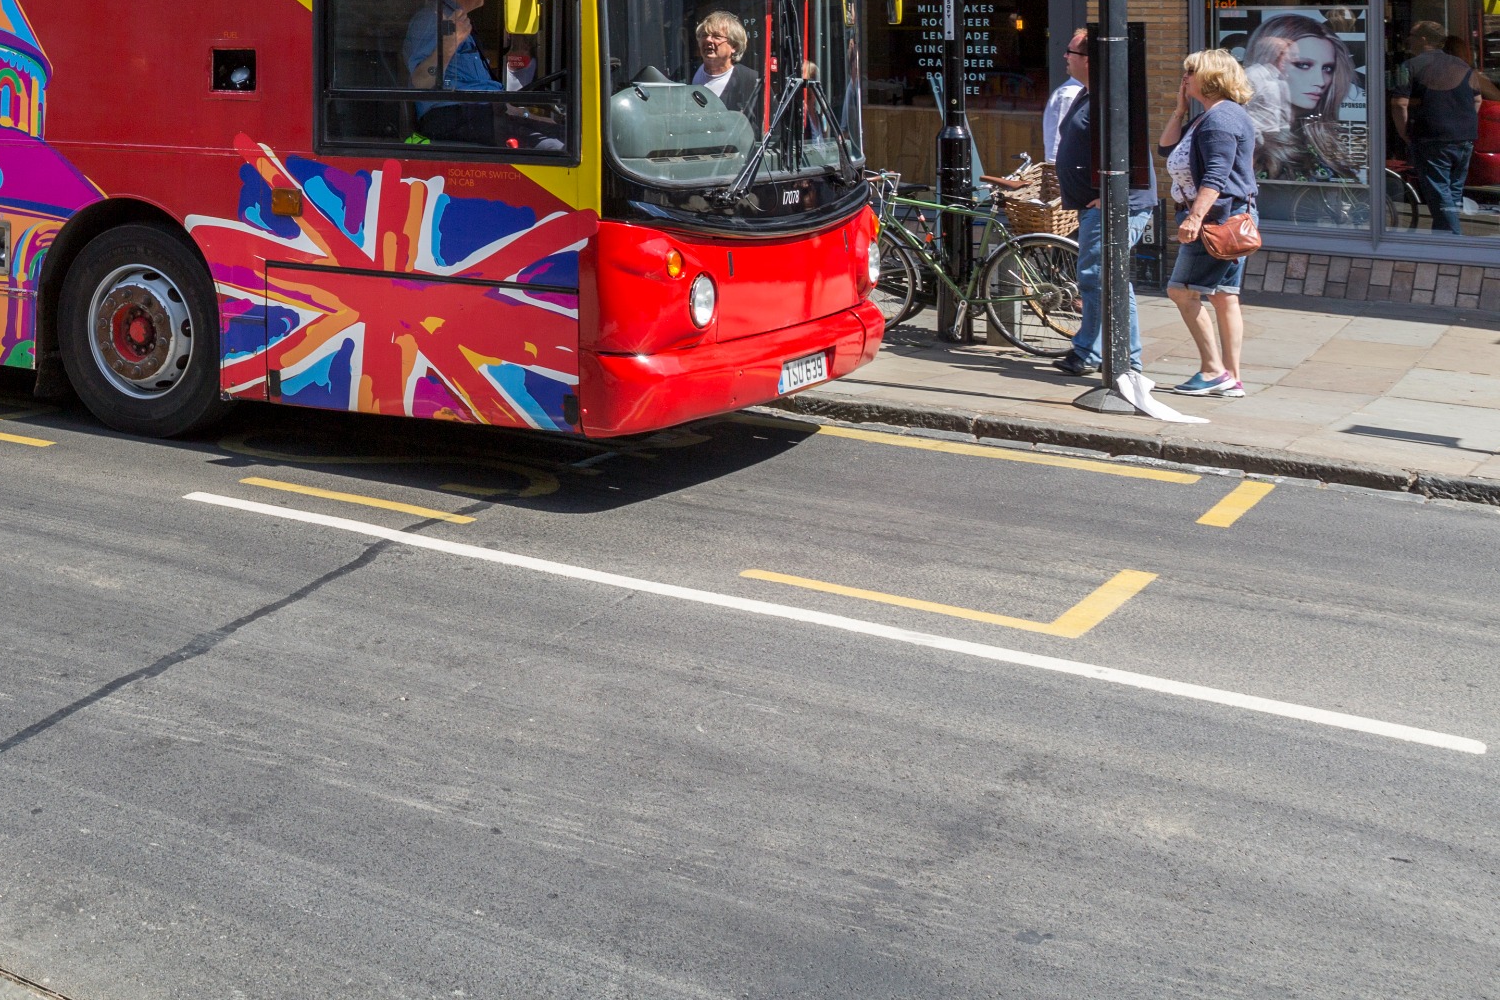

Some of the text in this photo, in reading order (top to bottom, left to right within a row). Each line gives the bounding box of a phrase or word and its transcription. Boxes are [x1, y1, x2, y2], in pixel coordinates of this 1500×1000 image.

[917, 4, 994, 13] MILAKES
[922, 31, 989, 40] LEMADE
[915, 44, 997, 54] GING BEER
[918, 58, 943, 67] CRA
[448, 168, 521, 180] ISOLATOR SWITCH
[448, 178, 475, 187] IN CAB
[783, 190, 800, 205] 17078
[805, 356, 823, 381] 639
